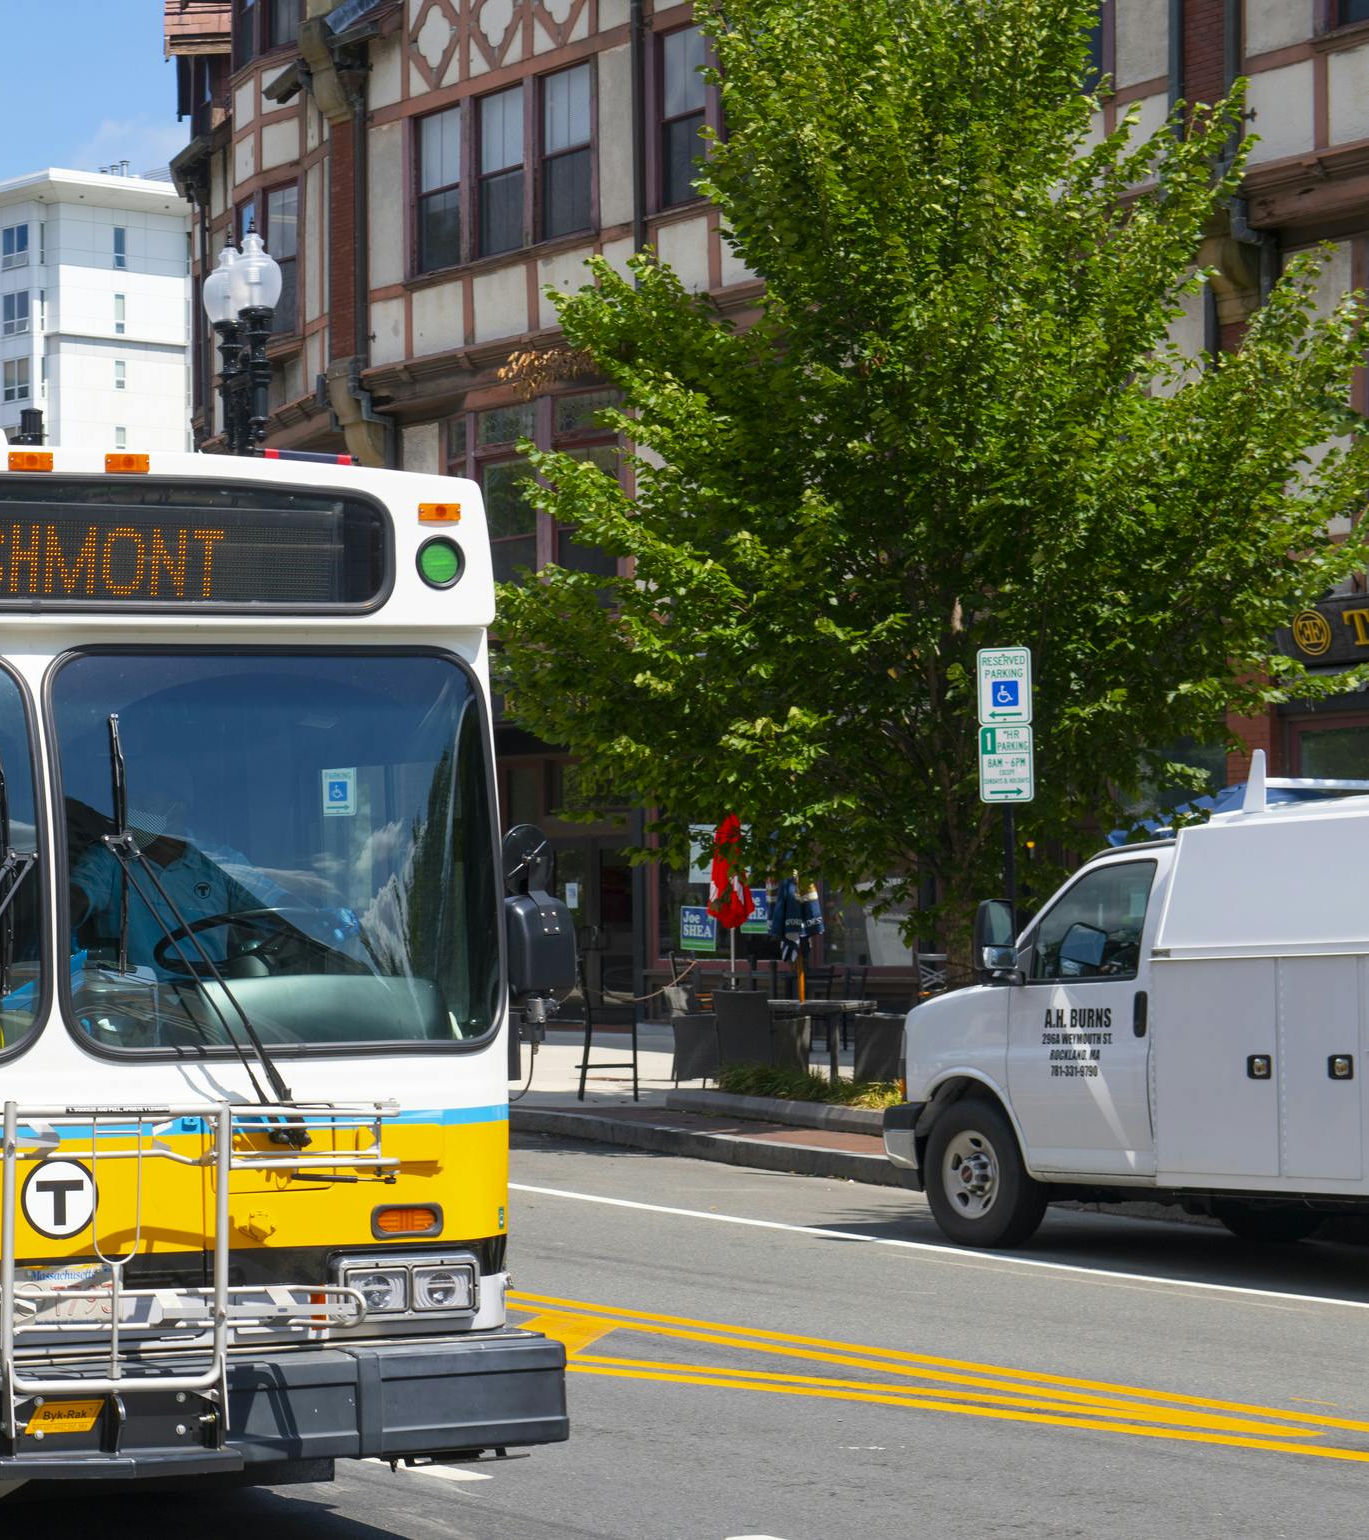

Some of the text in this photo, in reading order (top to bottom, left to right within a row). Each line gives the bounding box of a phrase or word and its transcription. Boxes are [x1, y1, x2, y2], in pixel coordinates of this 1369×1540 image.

[982, 656, 1025, 666] RESERVED
[985, 669, 1023, 678] PARKING
[985, 730, 1019, 751] 1 HR
[998, 741, 1029, 751] PARKING
[987, 758, 1003, 768] 8AM
[1011, 758, 1026, 767] 6PM
[683, 910, 701, 923] Joe
[683, 924, 713, 938] SHEA
[1044, 1008, 1112, 1028] A.H. BURNS
[1061, 1033, 1101, 1045] WEYMOUTH
[1089, 1050, 1101, 1060] MA
[1051, 1065, 1098, 1077] 781-331-9790
[36, 1179, 84, 1226] T
[31, 1268, 96, 1281] Massachusetts
[43, 1410, 87, 1422] Byk-Rak
